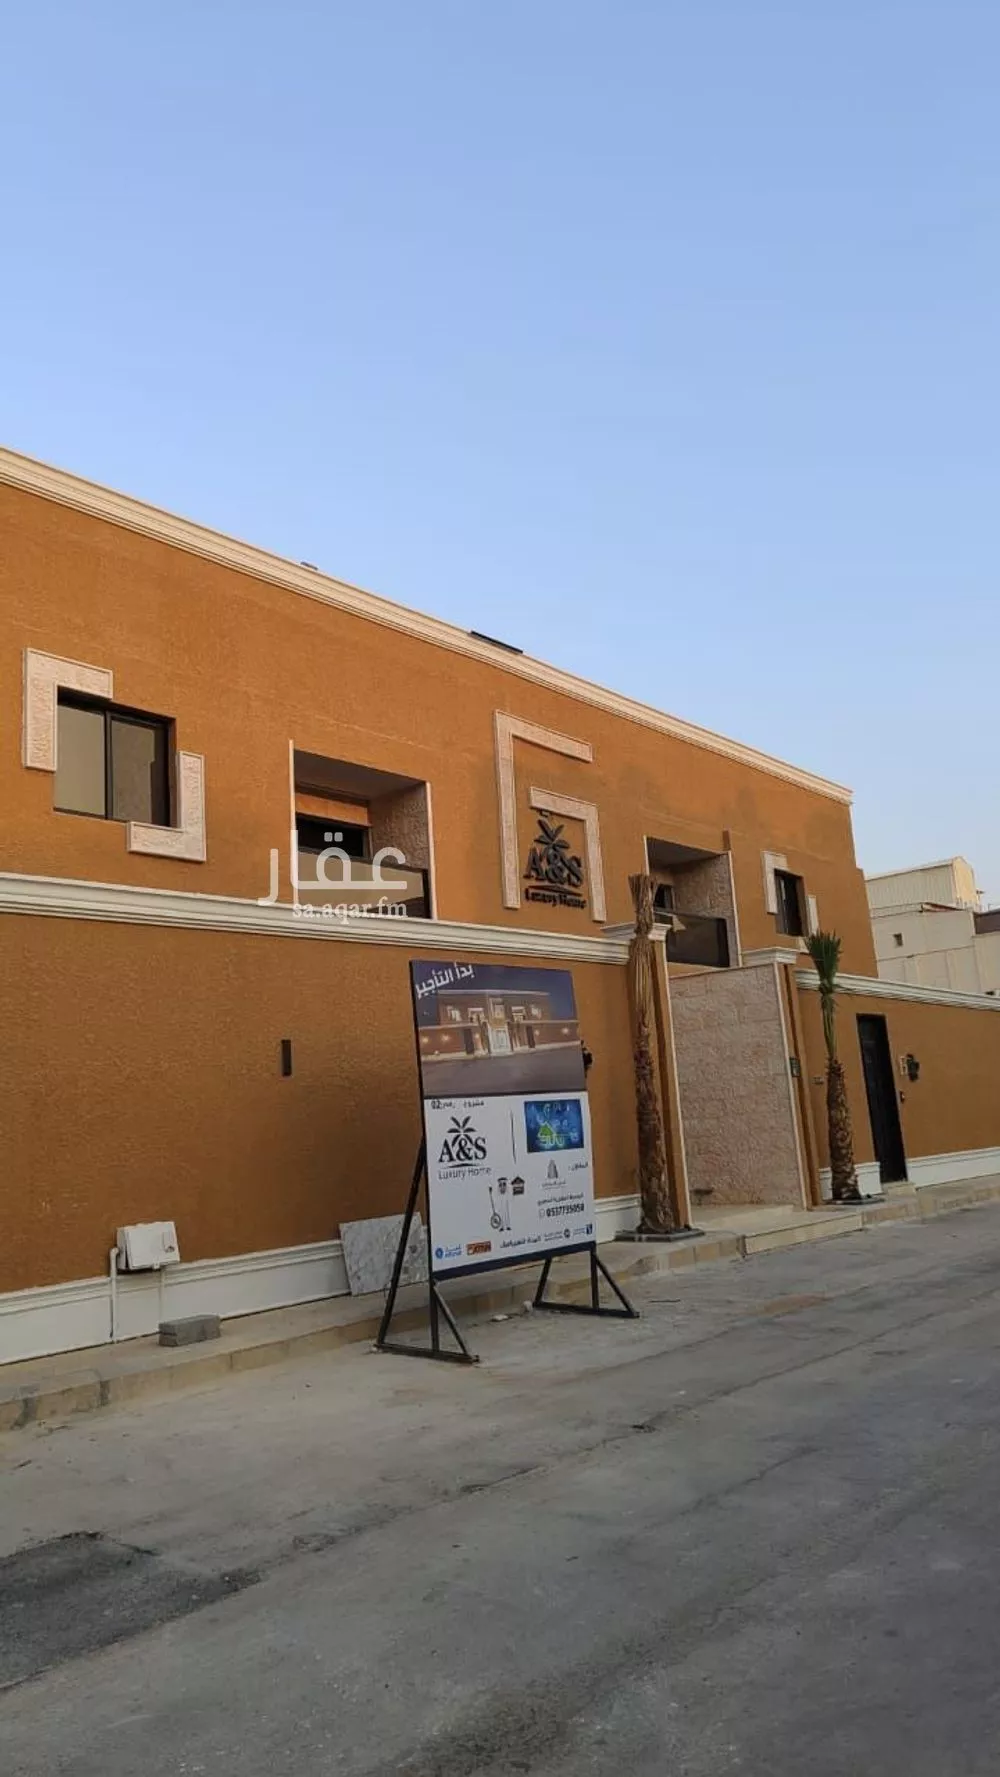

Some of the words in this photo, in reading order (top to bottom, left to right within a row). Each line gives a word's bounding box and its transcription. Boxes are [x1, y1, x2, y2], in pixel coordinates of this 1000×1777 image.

[523, 846, 583, 888] A&S
[415, 968, 454, 1000] التأجير
[454, 961, 475, 980] بدأ
[438, 1136, 487, 1163] A&S
[439, 1169, 466, 1180] Luxury
[468, 1167, 492, 1177] Home
